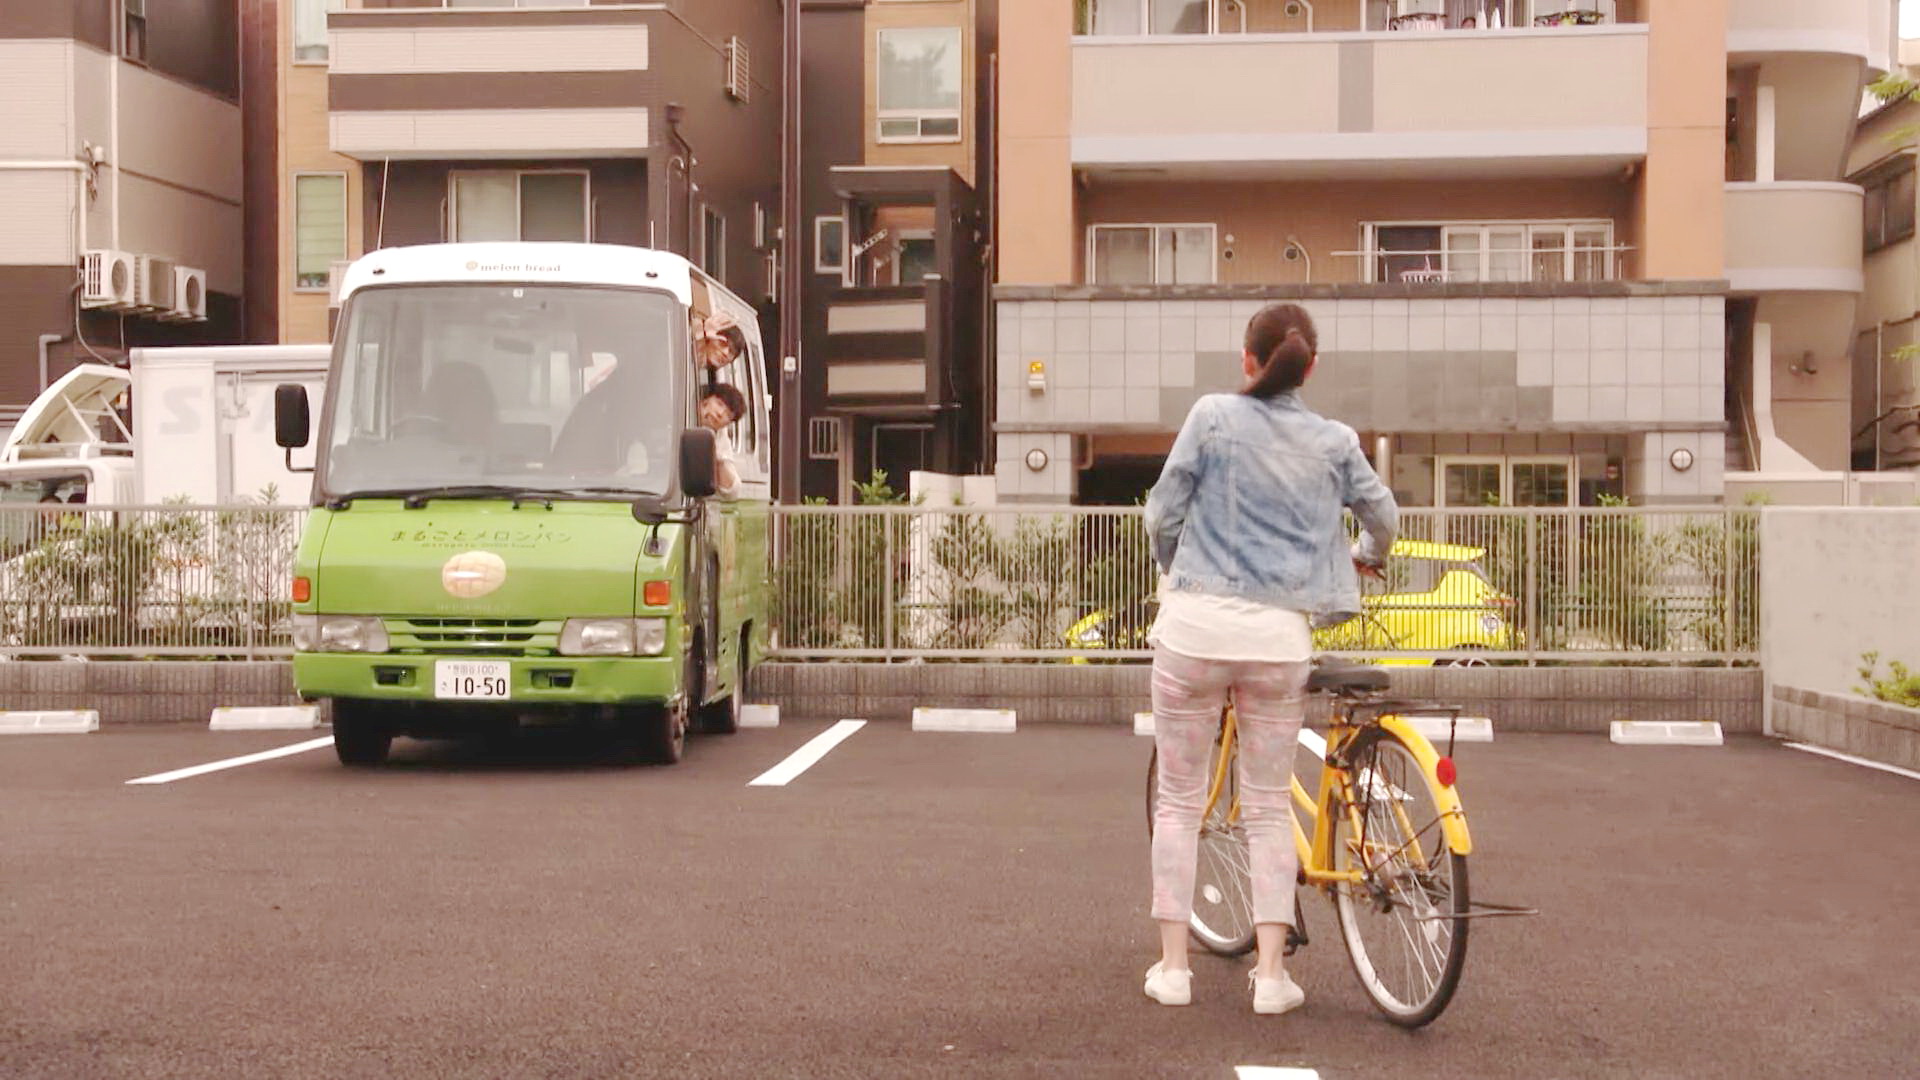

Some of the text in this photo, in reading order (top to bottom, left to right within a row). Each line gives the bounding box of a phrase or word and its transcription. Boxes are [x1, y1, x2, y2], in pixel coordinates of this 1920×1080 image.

[480, 263, 561, 272] melon bread
[391, 530, 572, 543] まるごとメロンパン
[455, 676, 506, 696] 10-50
